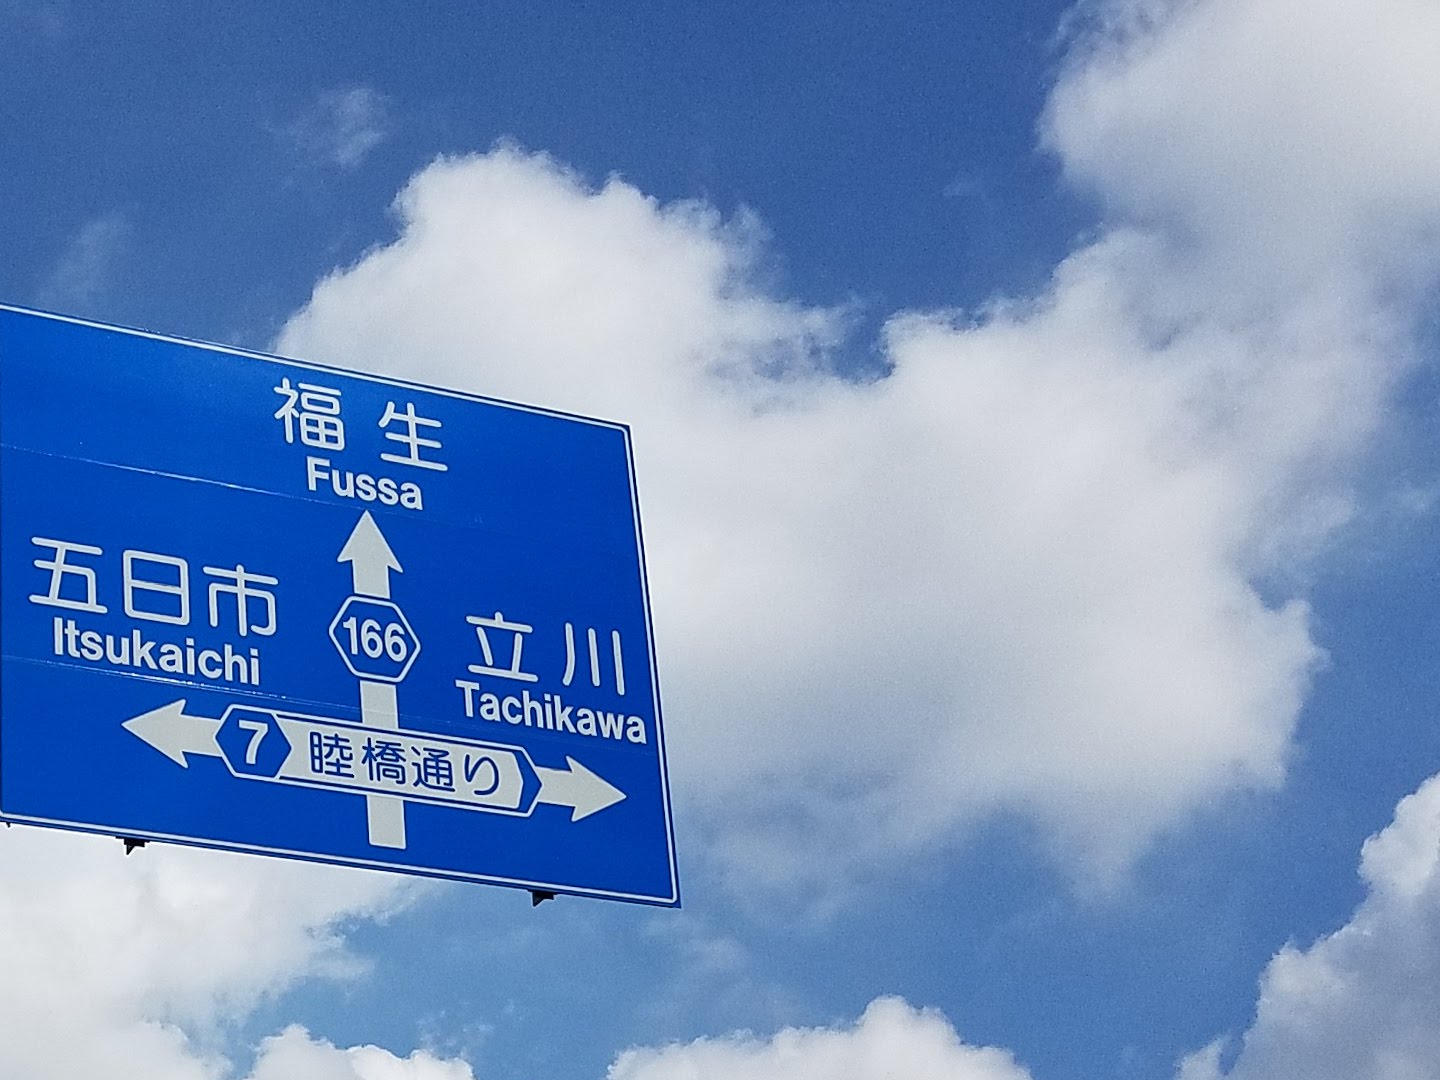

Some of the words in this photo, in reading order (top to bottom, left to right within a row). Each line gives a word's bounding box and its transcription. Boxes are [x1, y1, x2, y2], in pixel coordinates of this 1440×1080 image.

[273, 378, 448, 471] 福生
[306, 456, 423, 511] Fussa
[28, 536, 279, 638] 五日市
[53, 617, 260, 686] Itsukaichi
[342, 615, 408, 663] 166
[465, 611, 625, 696] 立川
[237, 720, 269, 765] 7
[455, 679, 647, 745] Tachikawa
[309, 730, 501, 796] 睦橋通り
